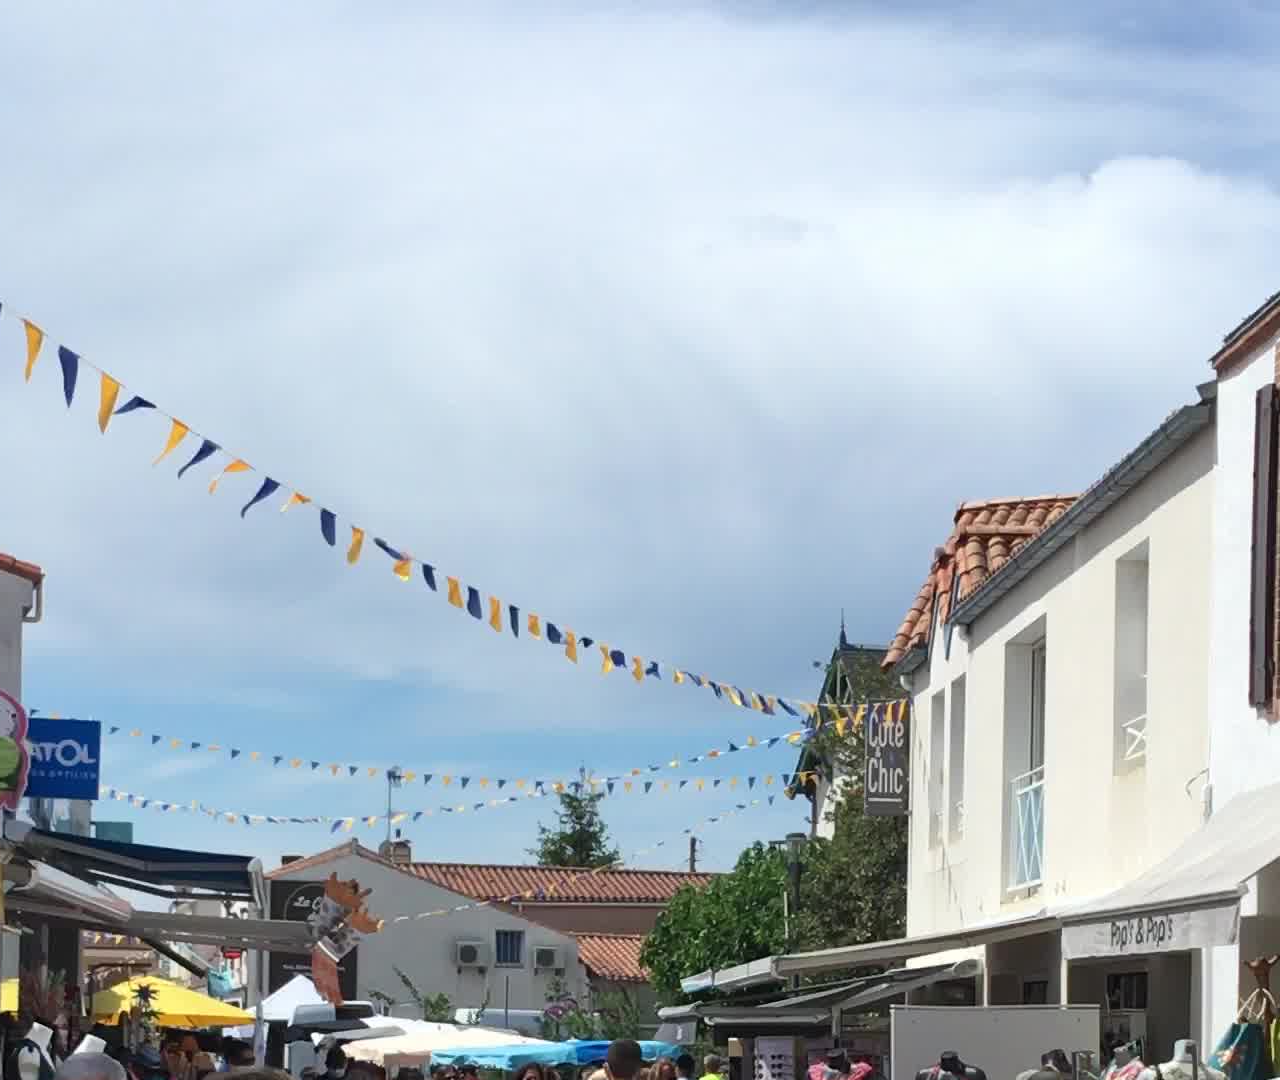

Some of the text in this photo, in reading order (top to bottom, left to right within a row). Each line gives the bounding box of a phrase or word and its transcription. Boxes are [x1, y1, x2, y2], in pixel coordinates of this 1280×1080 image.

[868, 758, 904, 794] Chic
[1110, 915, 1174, 950] Pop's & Pop's
